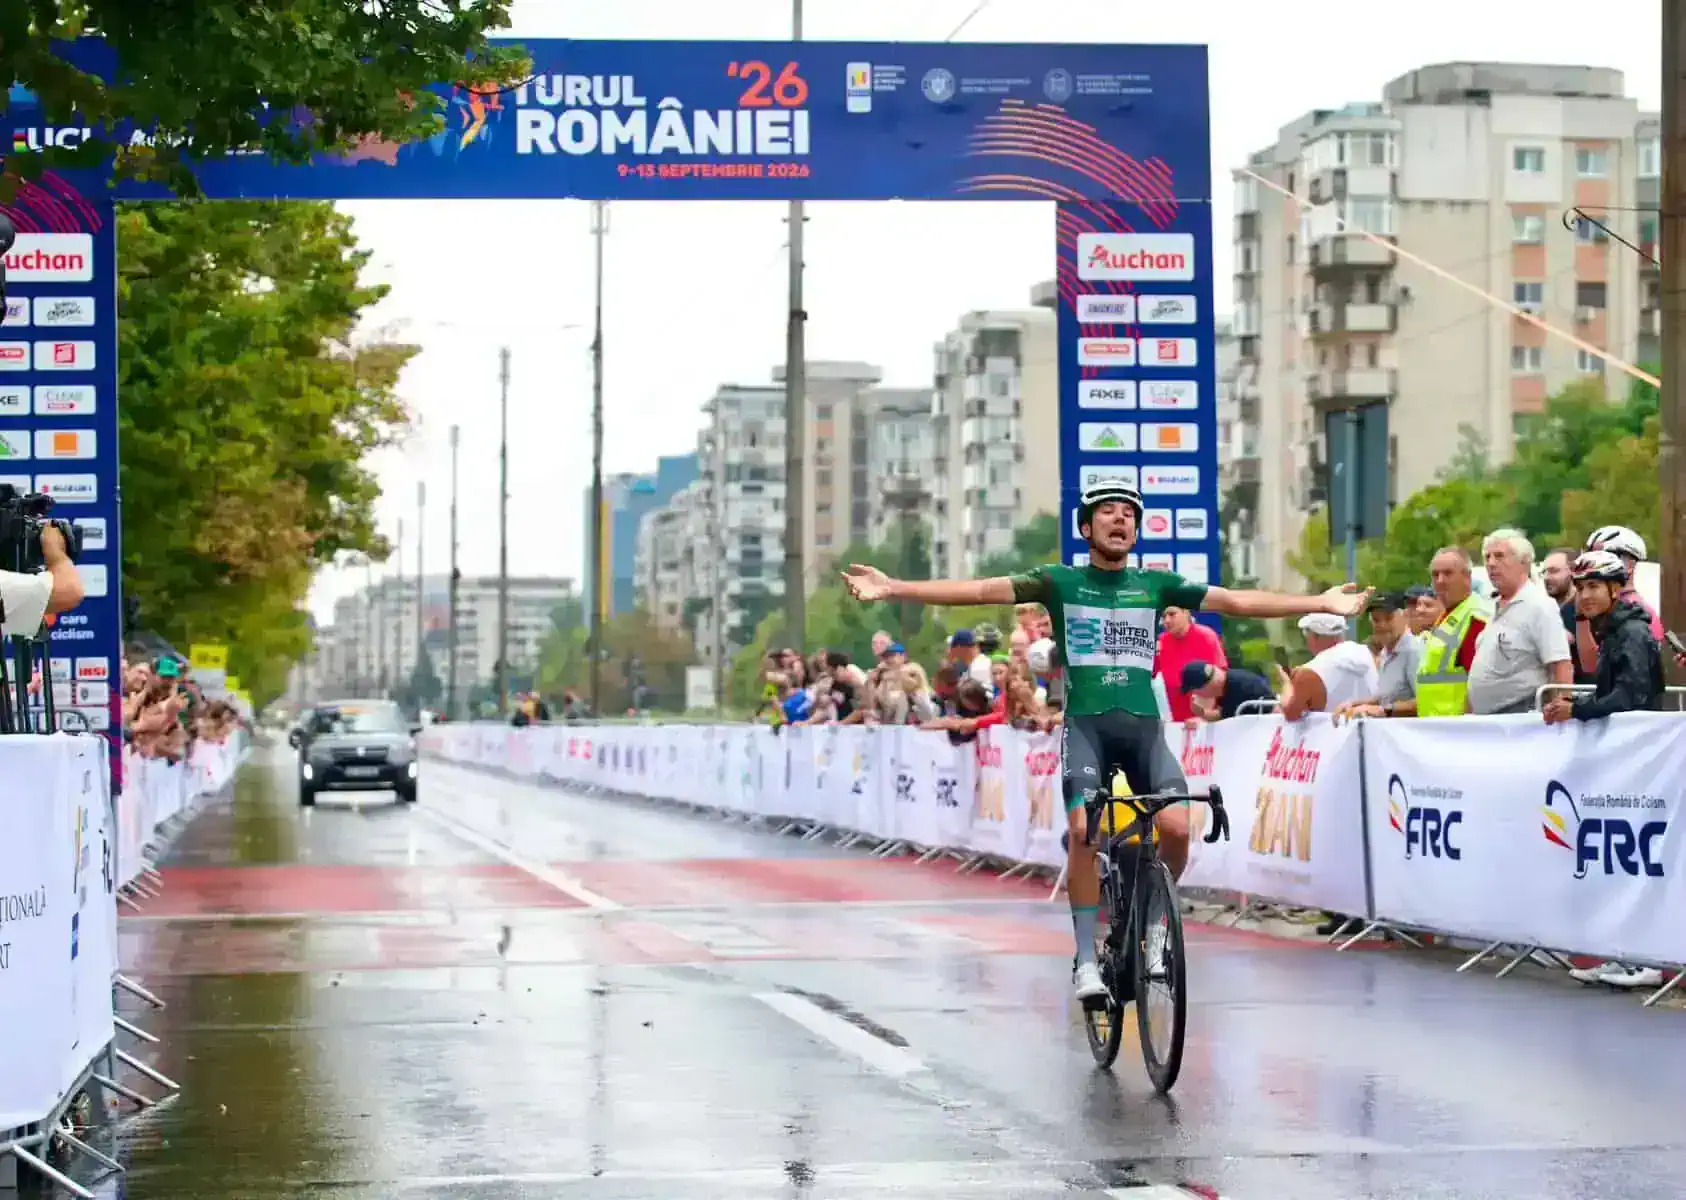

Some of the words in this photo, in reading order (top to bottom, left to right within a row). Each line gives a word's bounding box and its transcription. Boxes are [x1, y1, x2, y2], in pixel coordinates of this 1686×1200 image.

[515, 75, 646, 107] TURUL
[516, 97, 810, 155] ROMÂNIEI
[658, 163, 763, 178] SEPTEMBRIE
[767, 162, 810, 177] 2026
[3, 249, 84, 270] uchan
[1088, 244, 1185, 269] Auchan
[60, 615, 88, 625] care
[1104, 626, 1148, 639] UNITED
[50, 628, 95, 640] ciclism
[1405, 807, 1463, 860] FRC
[1576, 818, 1667, 878] FRC
[0, 885, 47, 928] ȚIONALĂ
